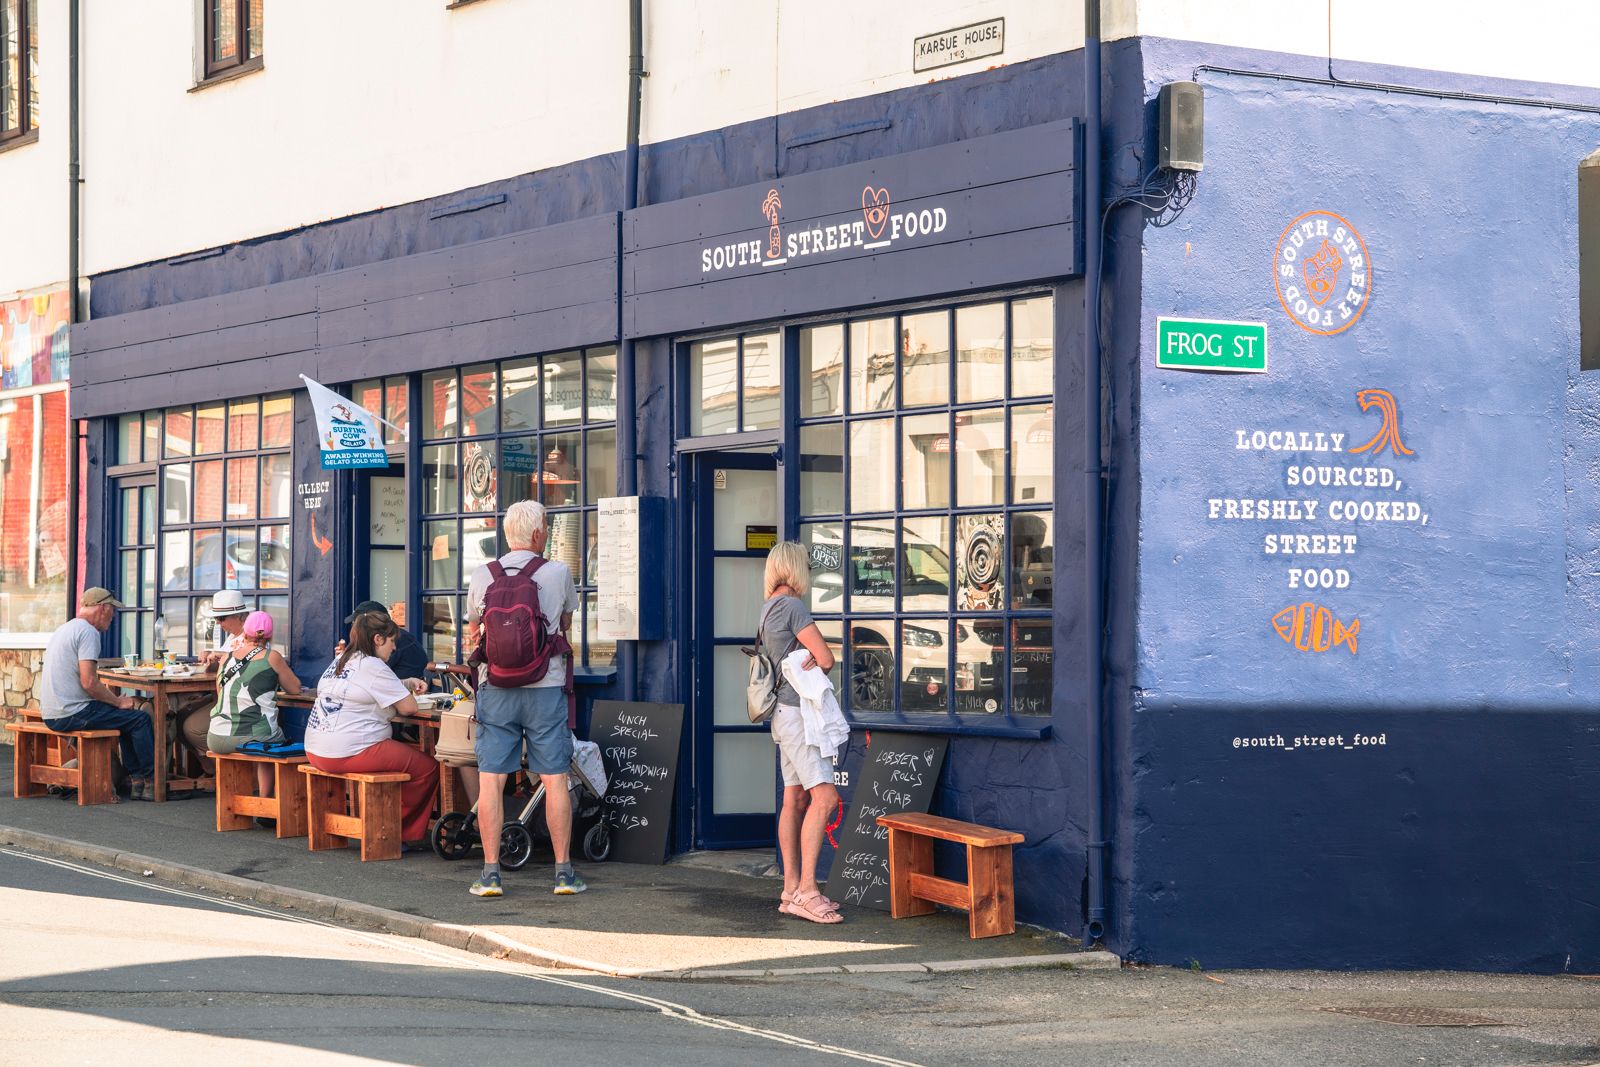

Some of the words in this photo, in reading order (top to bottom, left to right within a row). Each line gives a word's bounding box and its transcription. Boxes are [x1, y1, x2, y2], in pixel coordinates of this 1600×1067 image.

[920, 36, 958, 56] KARSUE
[964, 26, 998, 45] HOUSE
[702, 240, 762, 272] SOUTH
[787, 221, 864, 258] STREET
[890, 207, 947, 240] FOOD
[1281, 220, 1329, 277] SOUTH
[1333, 227, 1365, 319] STREET
[1286, 286, 1333, 326] FOOD
[1167, 331, 1222, 357] FROG
[1233, 335, 1258, 358] ST
[1236, 430, 1345, 452] LOCALLY
[1287, 466, 1402, 491] SOURCED,
[1208, 499, 1319, 520] FRESHLY
[1328, 501, 1429, 526] COOKED,
[1265, 534, 1357, 554] STREET
[813, 549, 839, 567] OPEN
[1288, 568, 1350, 588] FOOD
[618, 710, 647, 726] LUNCH
[610, 725, 658, 741] SPECIAL
[1232, 733, 1387, 750] @south_street_food
[606, 746, 638, 767] CRAB
[621, 761, 668, 780] SANDWICH
[890, 769, 923, 787] ROLLS
[605, 794, 637, 807] CRISPS
[882, 789, 912, 809] CRAB
[855, 823, 872, 835] ALL
[841, 866, 872, 881] GELATO
[870, 875, 889, 888] ALL
[845, 885, 869, 906] DAY
